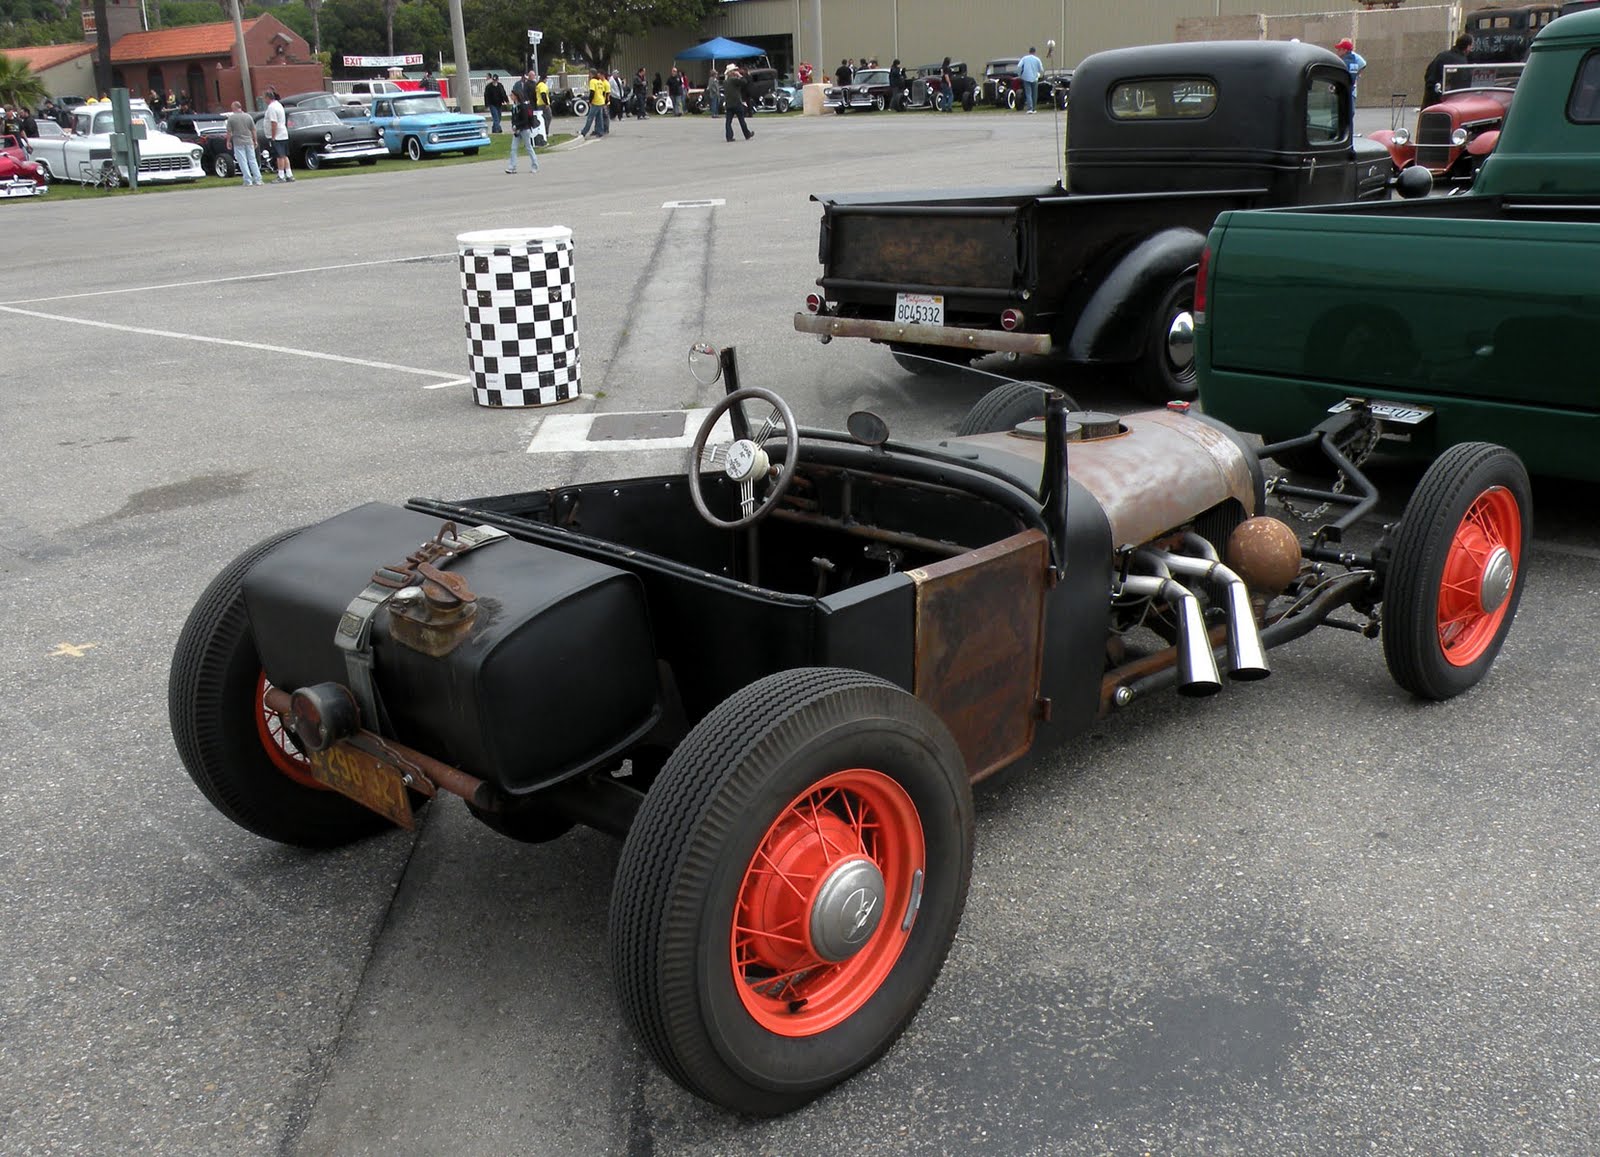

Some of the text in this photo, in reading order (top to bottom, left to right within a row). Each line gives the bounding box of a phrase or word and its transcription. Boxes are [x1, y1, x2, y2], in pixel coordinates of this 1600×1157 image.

[344, 57, 363, 66] EXIT
[405, 55, 422, 65] EXIT
[898, 303, 940, 323] 8C45332
